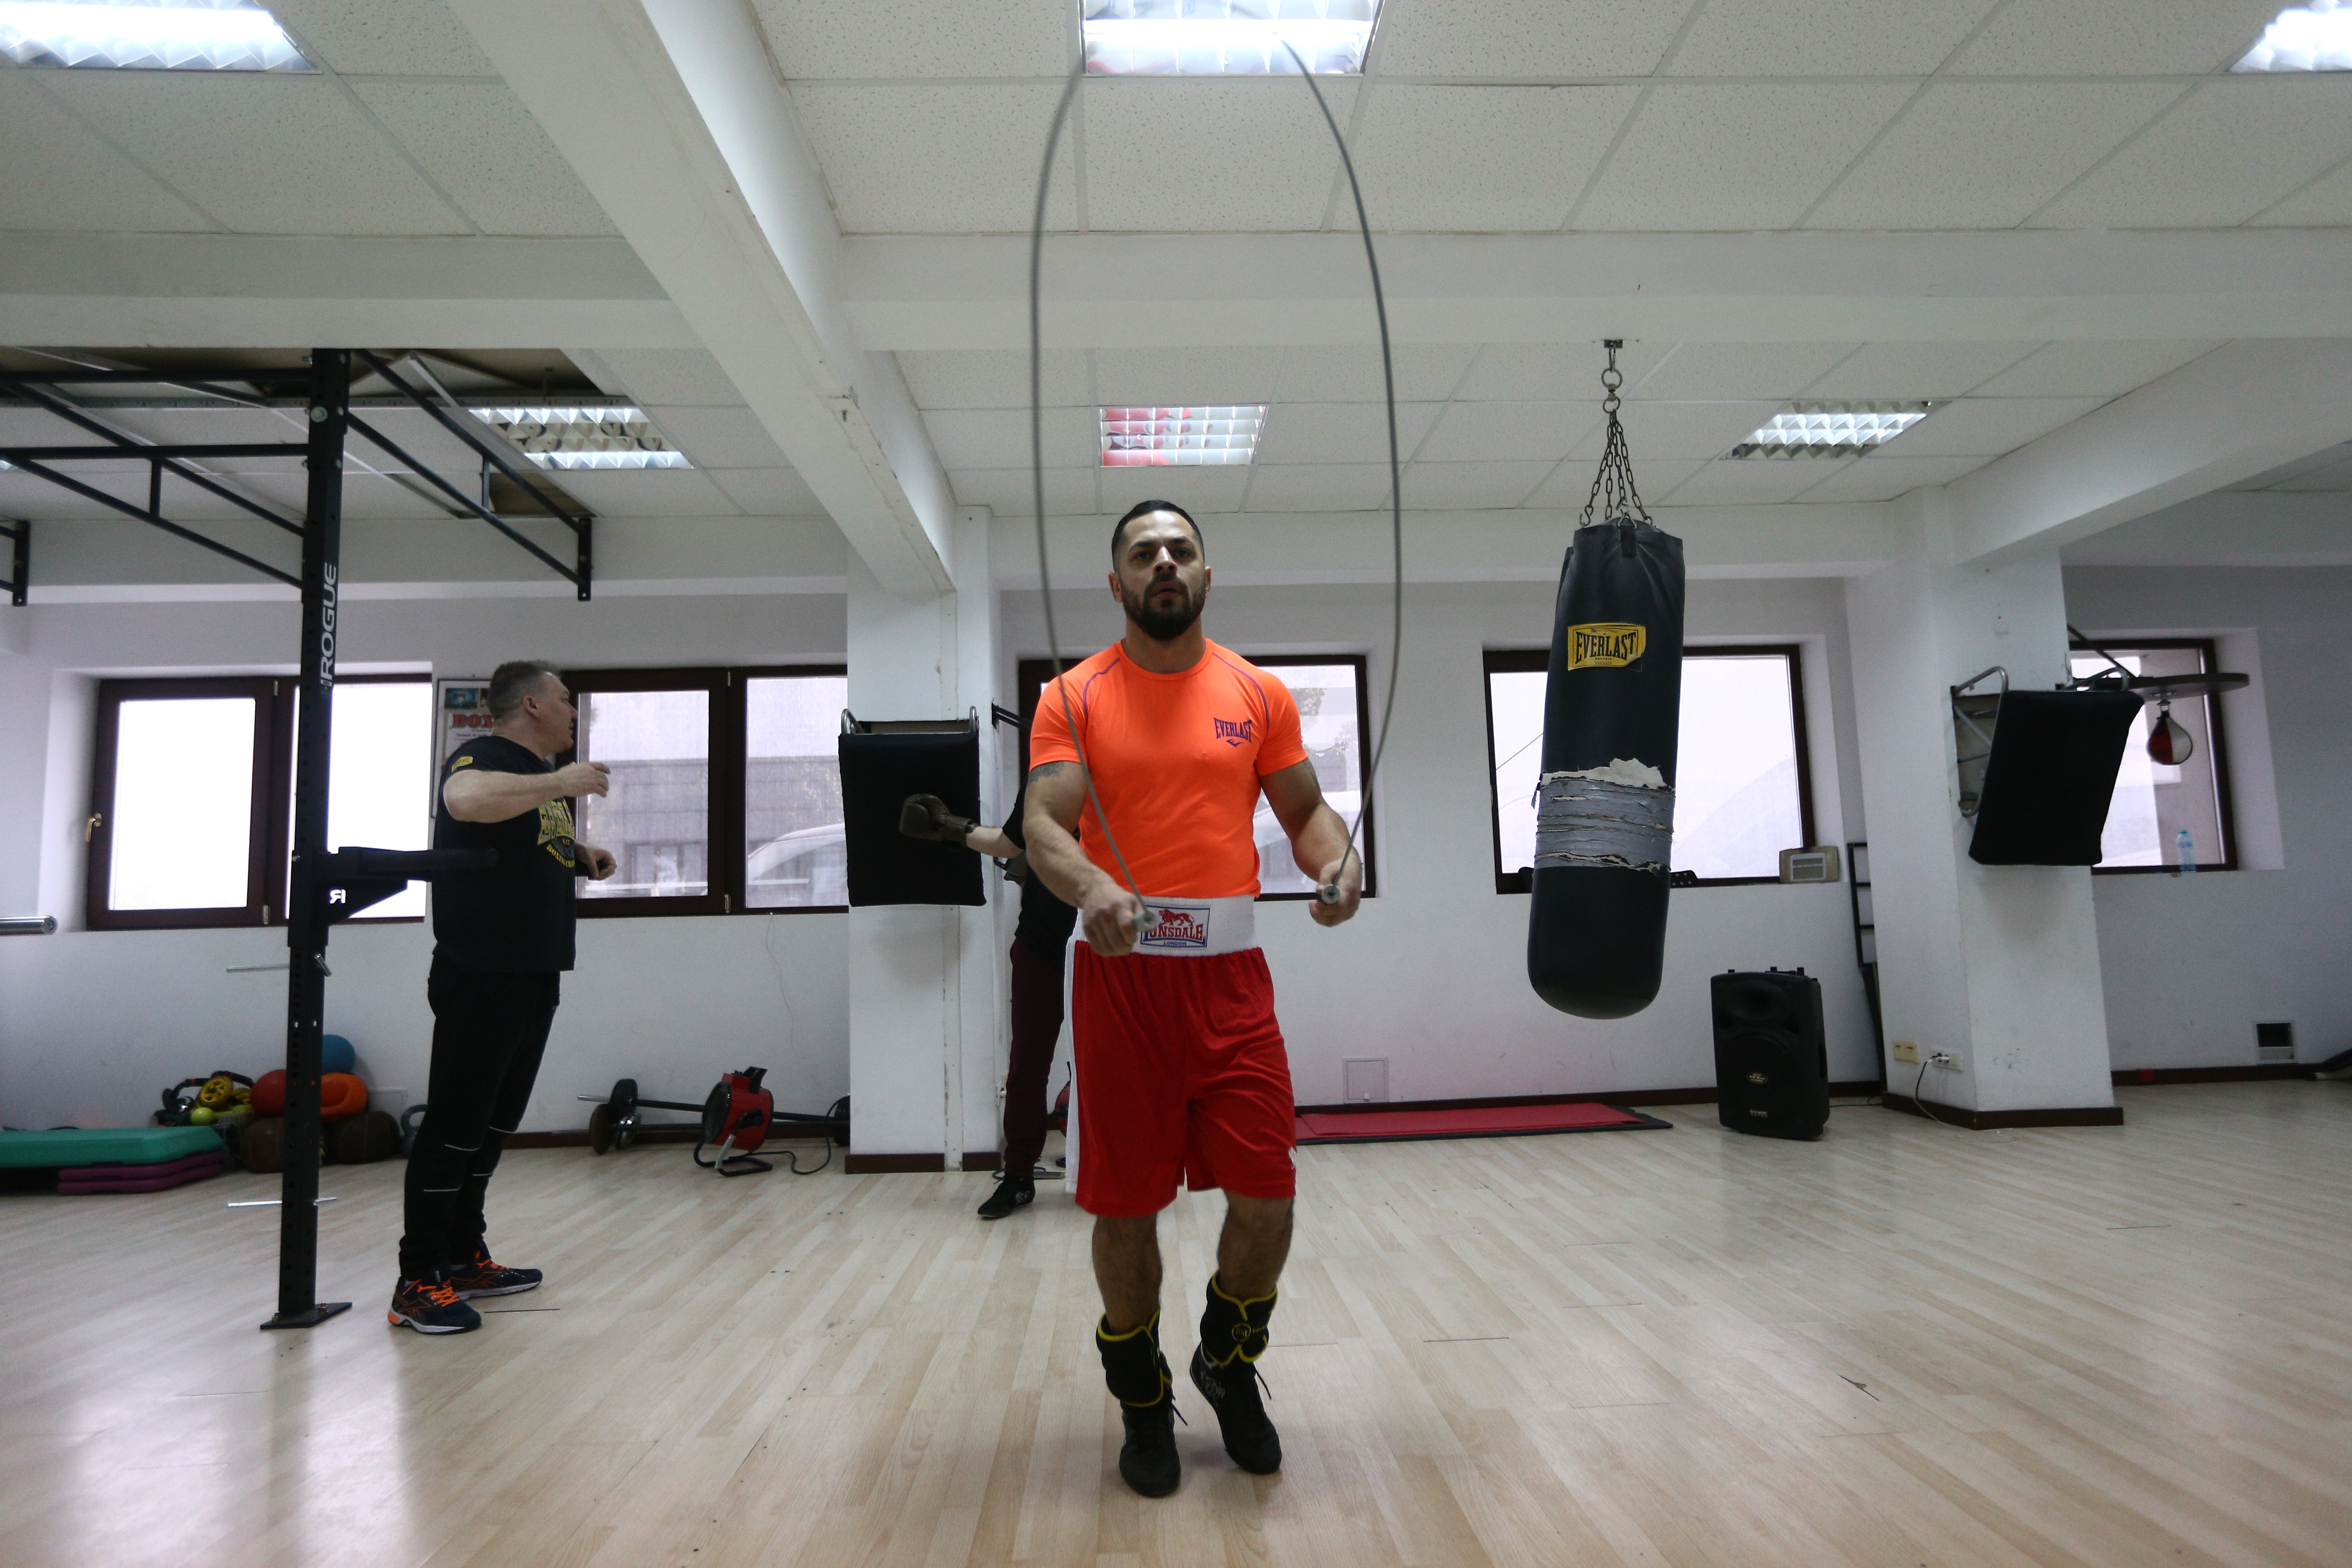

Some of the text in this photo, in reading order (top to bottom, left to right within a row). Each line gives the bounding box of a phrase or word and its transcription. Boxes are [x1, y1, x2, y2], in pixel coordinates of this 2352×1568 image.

[320, 562, 337, 681] ROGUE
[1575, 631, 1636, 664] EVERLAST
[1213, 717, 1252, 743] EVERLAST
